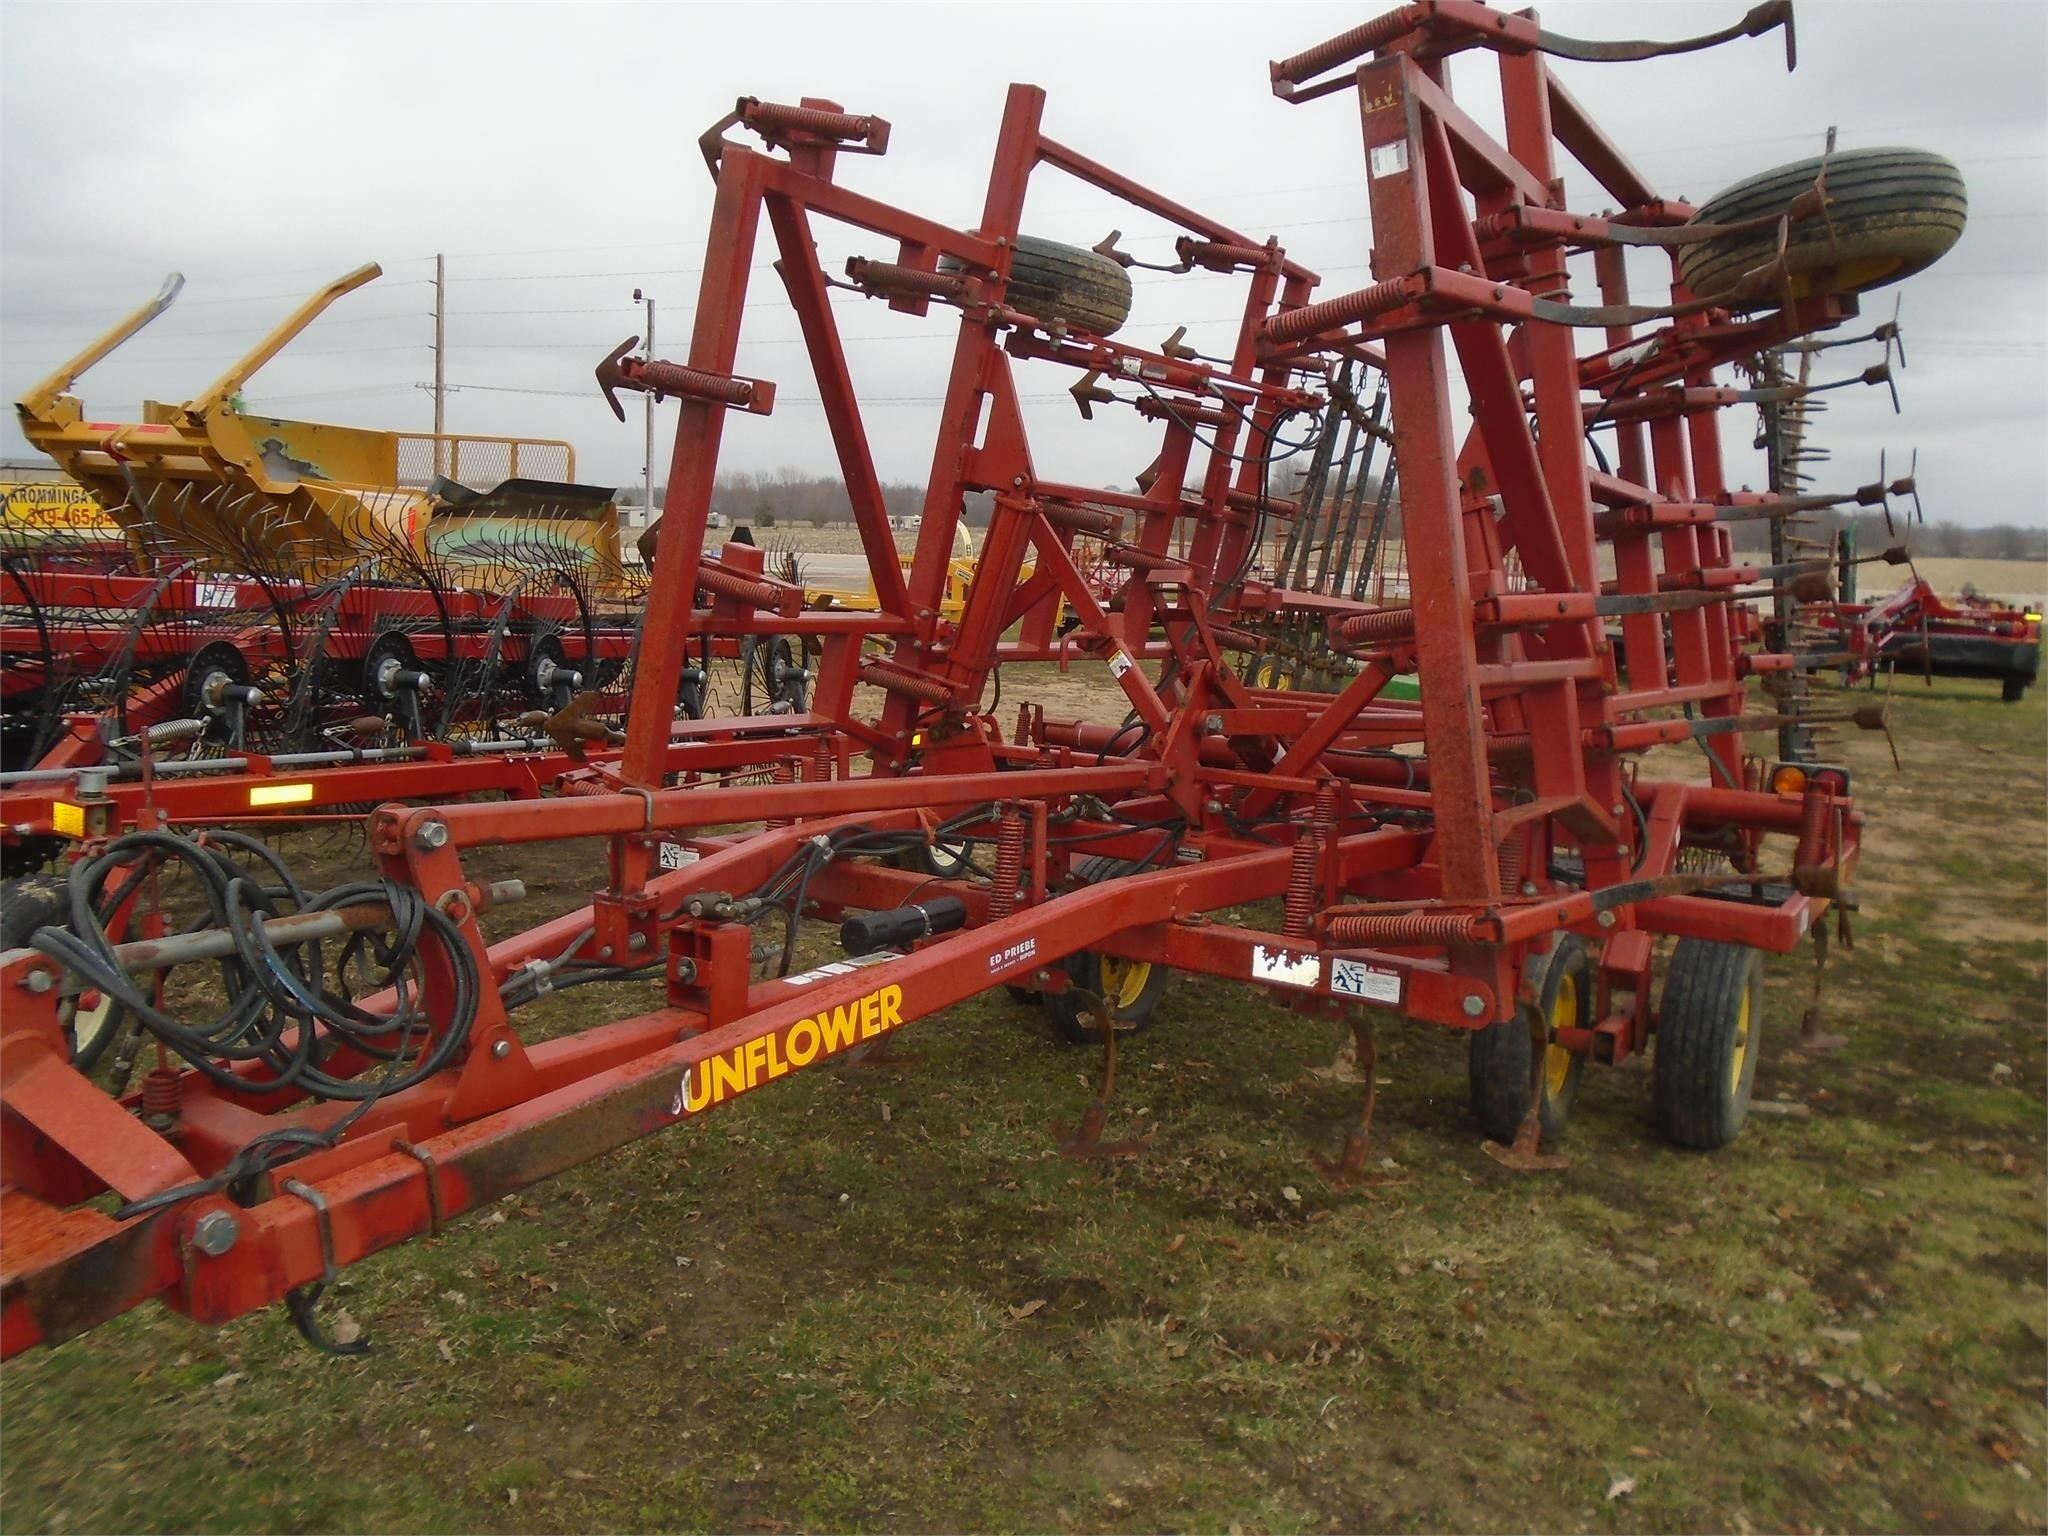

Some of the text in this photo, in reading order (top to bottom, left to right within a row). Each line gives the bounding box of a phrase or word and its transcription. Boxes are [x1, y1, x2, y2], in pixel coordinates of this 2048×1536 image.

[990, 953, 1002, 967] ED
[1004, 938, 1036, 960] PRIEBE
[672, 984, 903, 1115] UNFLOWER
